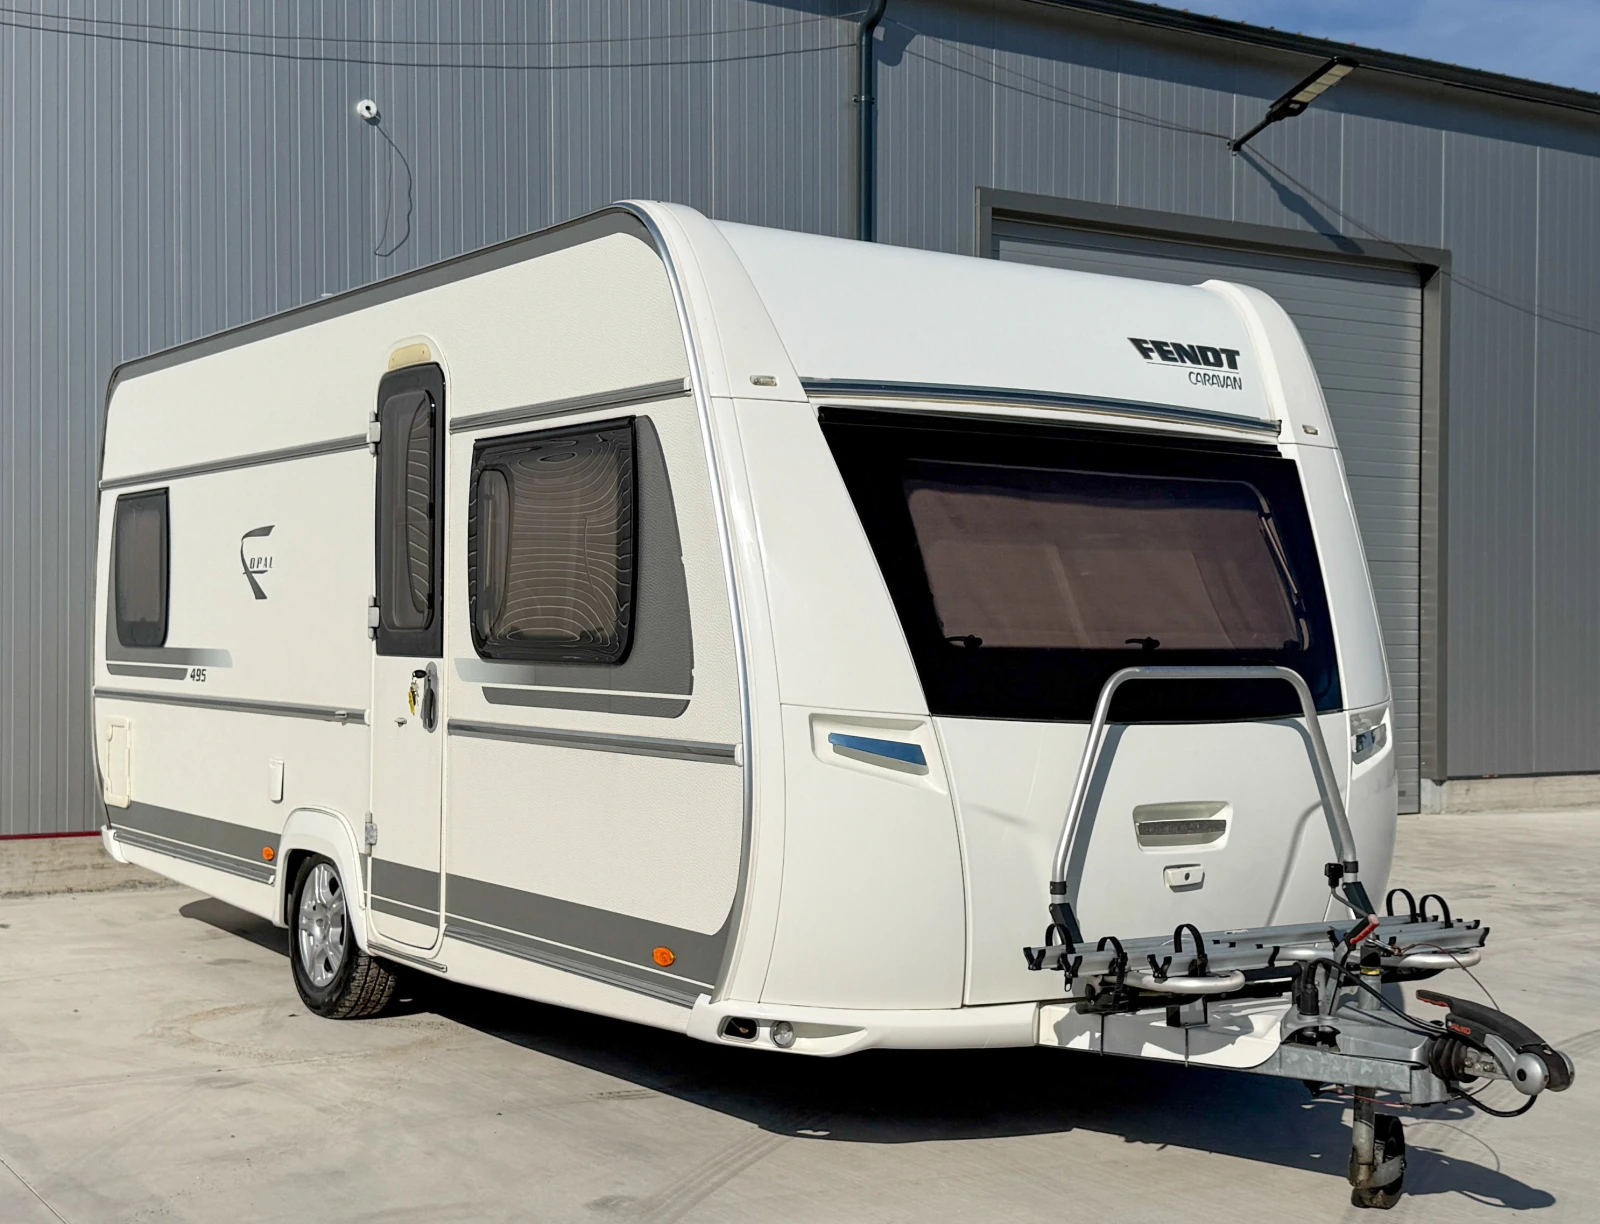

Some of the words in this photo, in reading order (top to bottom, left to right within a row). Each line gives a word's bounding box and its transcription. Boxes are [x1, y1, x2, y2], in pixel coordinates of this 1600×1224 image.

[1127, 337, 1240, 370] FENDT
[1188, 371, 1242, 390] CARAVAN
[250, 556, 273, 569] OPAL
[190, 668, 206, 682] 495
